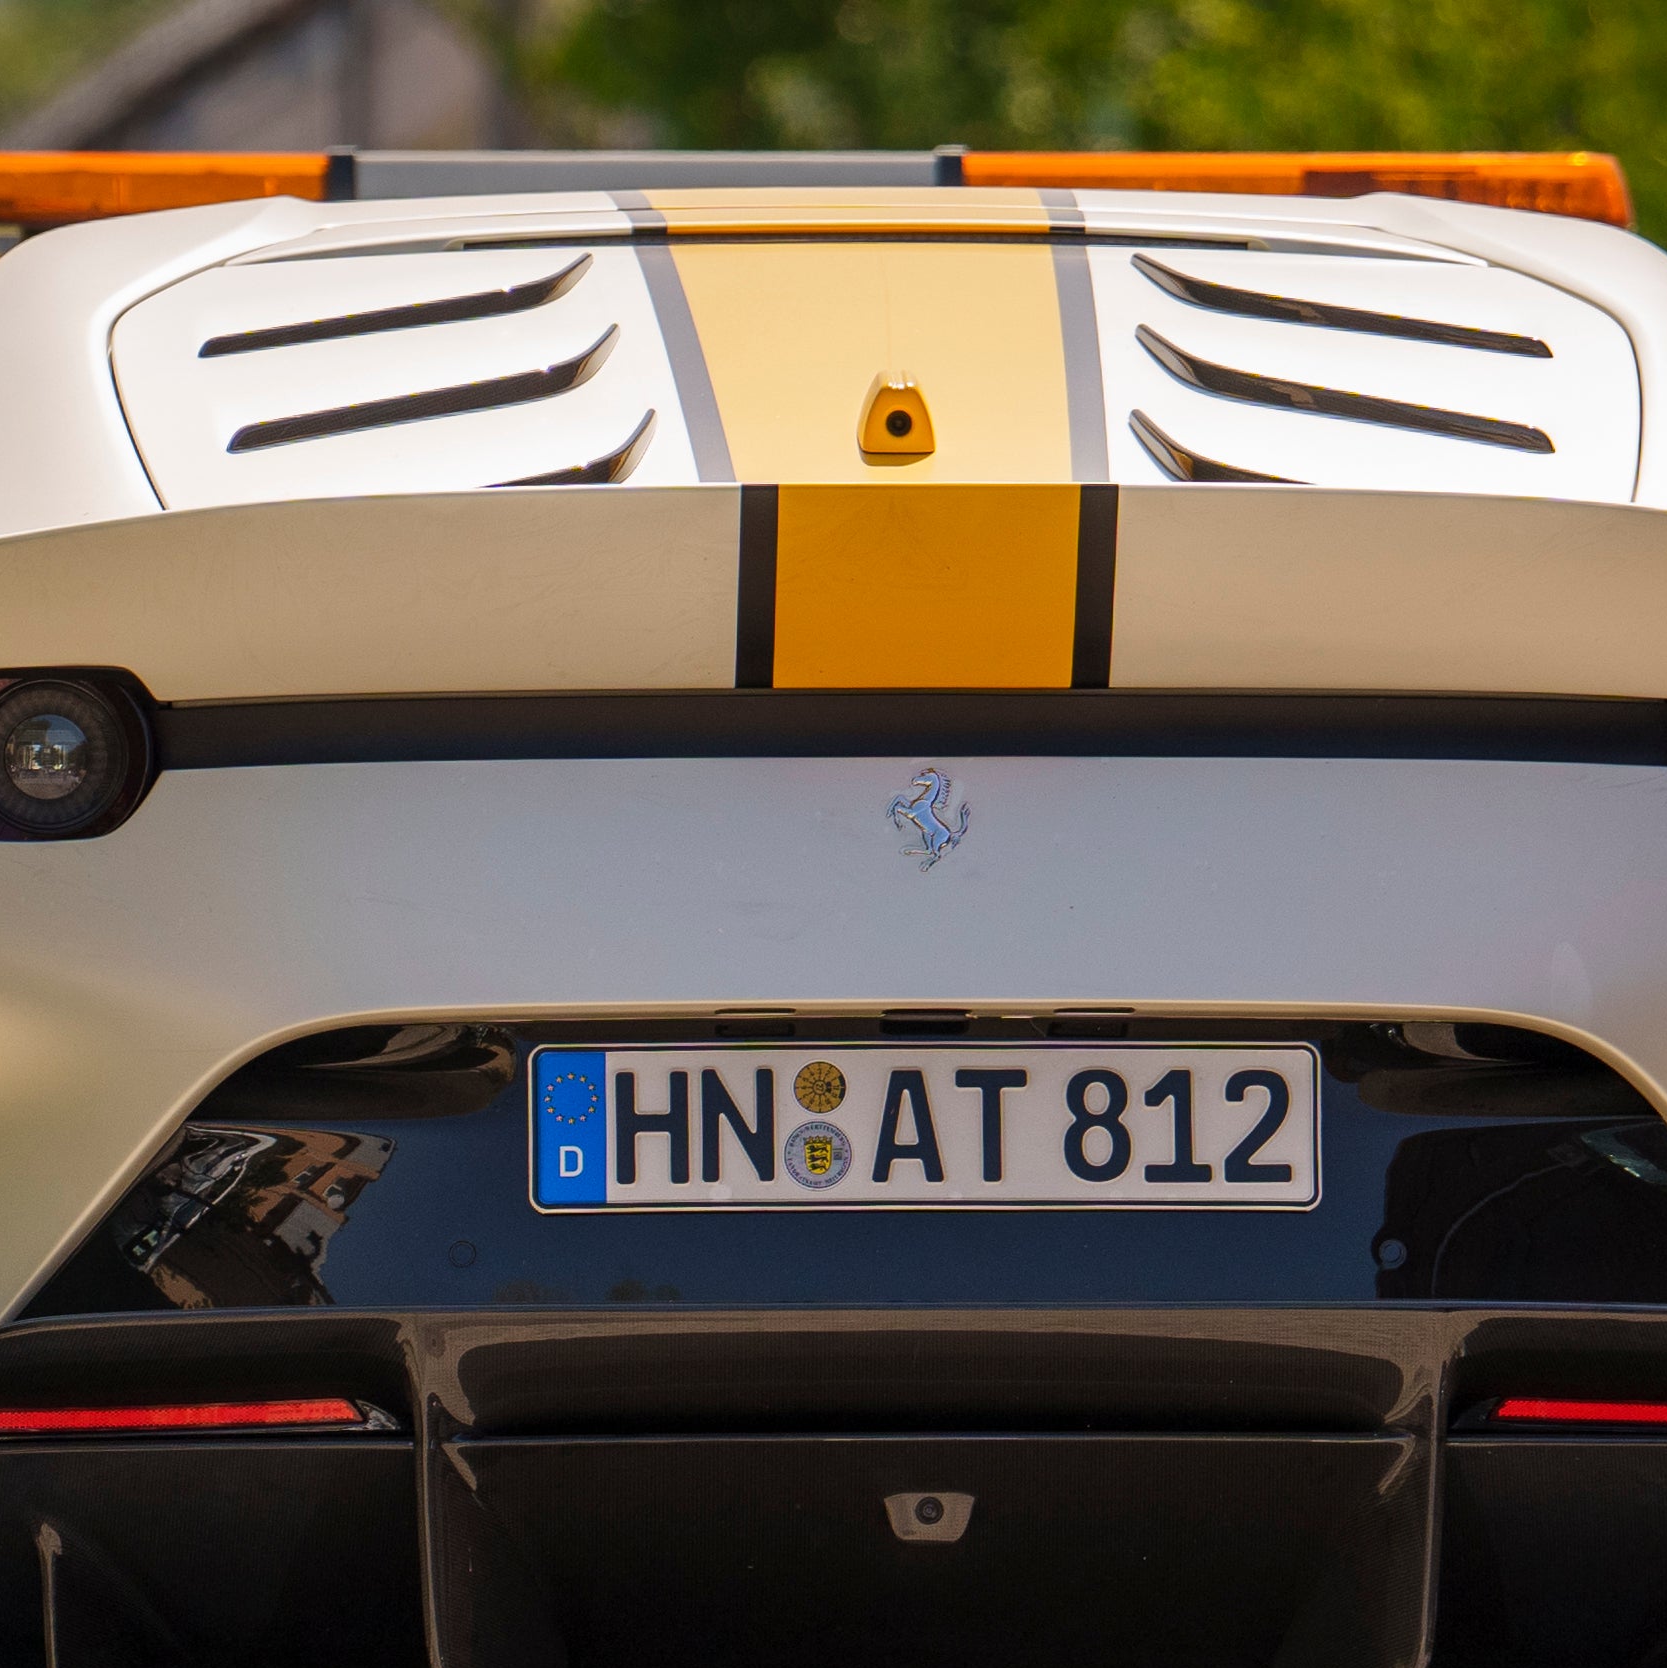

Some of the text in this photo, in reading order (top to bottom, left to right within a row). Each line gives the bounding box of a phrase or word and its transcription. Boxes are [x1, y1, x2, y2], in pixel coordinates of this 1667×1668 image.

[558, 1146, 585, 1178] D
[614, 1067, 1293, 1185] HN AT 812
